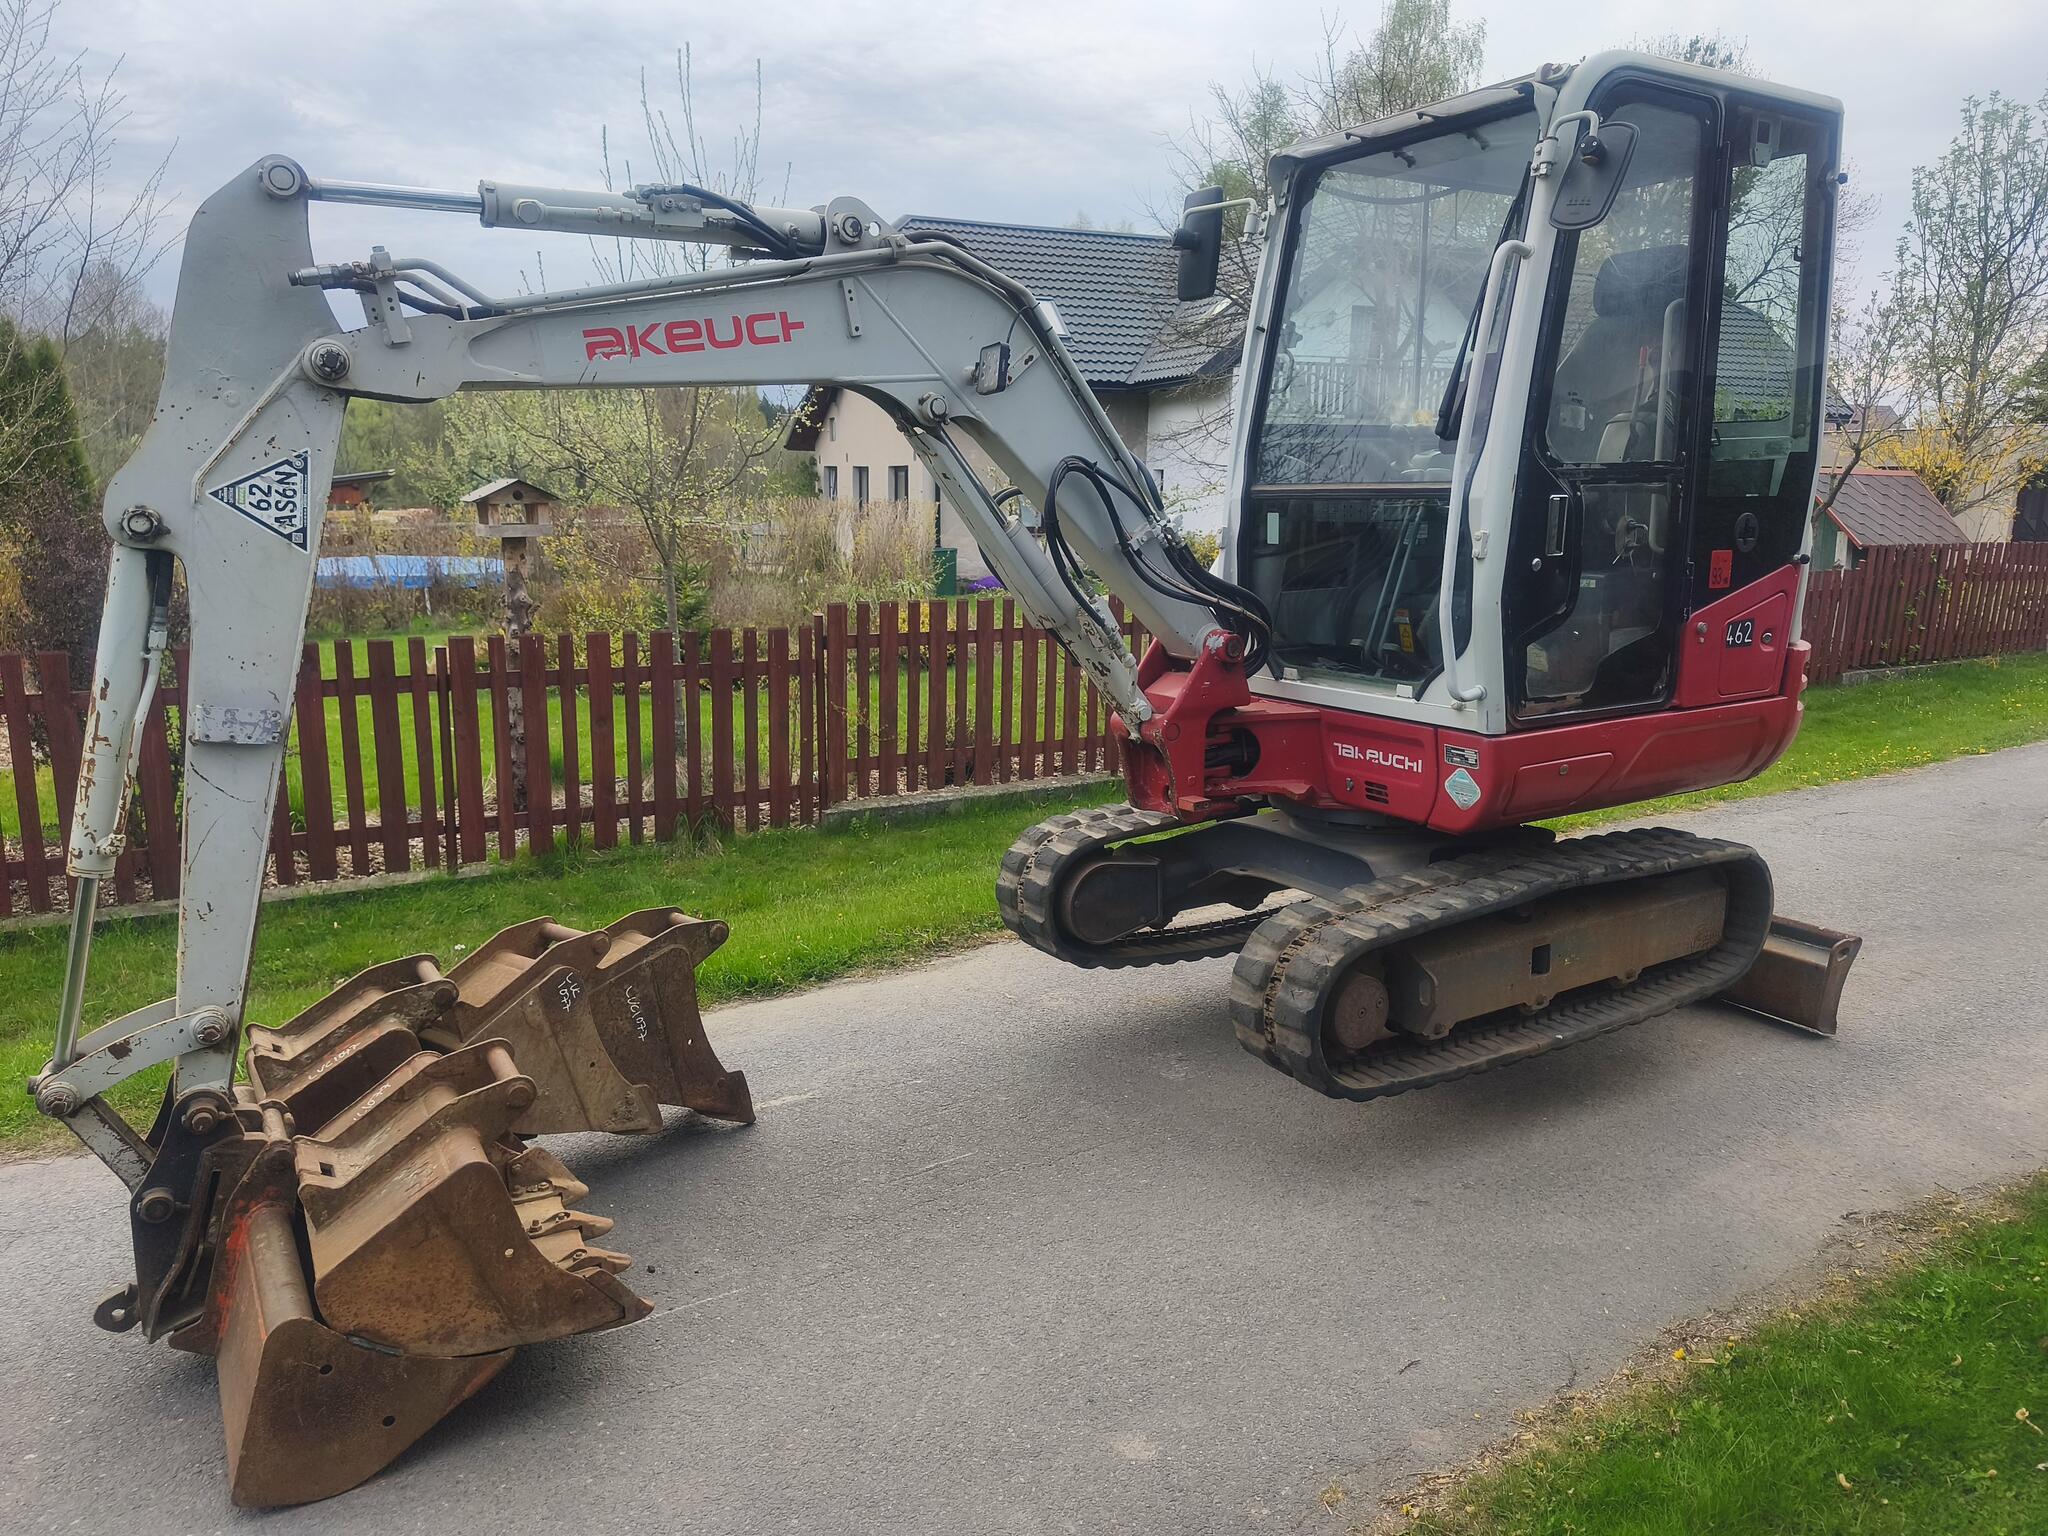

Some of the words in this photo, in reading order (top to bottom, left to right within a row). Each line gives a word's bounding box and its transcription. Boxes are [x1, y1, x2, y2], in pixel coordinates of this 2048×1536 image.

[248, 483, 272, 511] 62
[274, 471, 298, 528] AS6N
[1726, 621, 1752, 645] 462
[558, 981, 572, 1013] 1077
